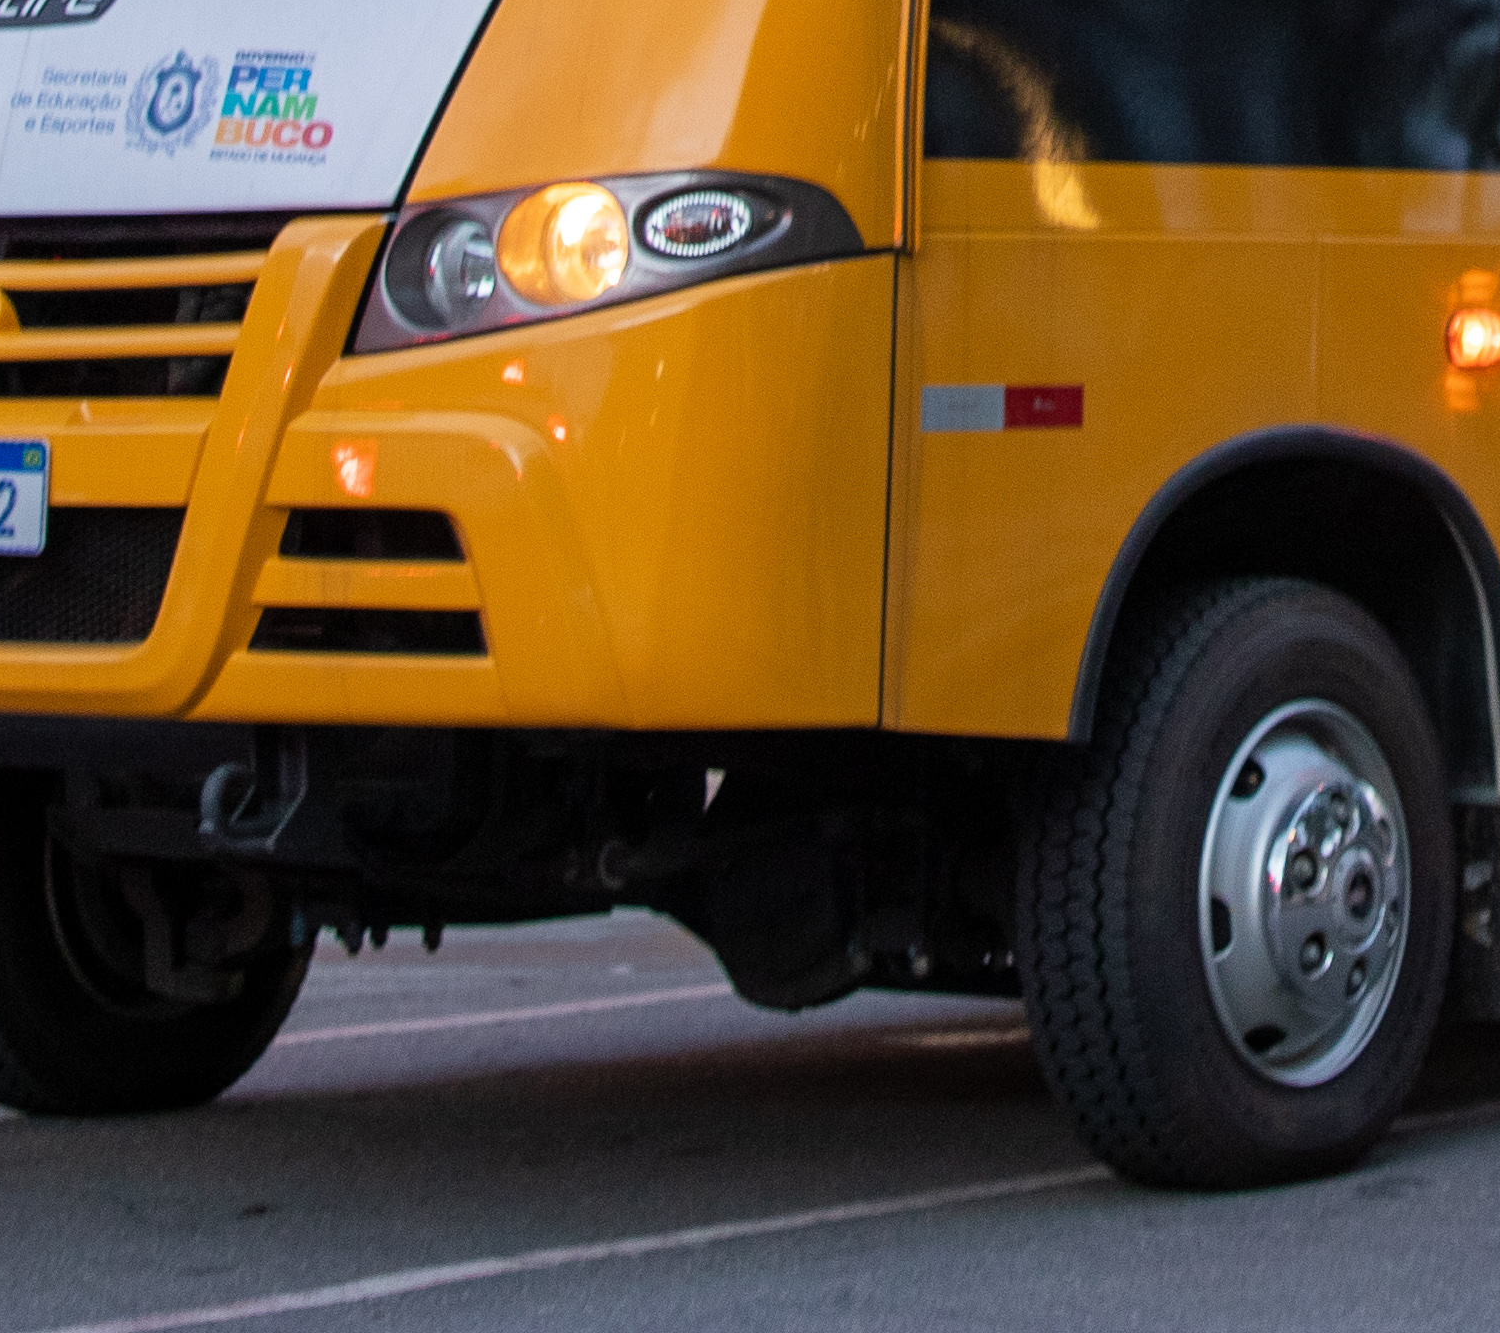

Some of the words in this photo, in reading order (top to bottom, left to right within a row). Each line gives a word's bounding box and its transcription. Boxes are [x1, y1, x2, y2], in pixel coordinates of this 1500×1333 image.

[229, 66, 312, 91] PER
[221, 93, 318, 119] NAM
[214, 118, 334, 149] BUCO
